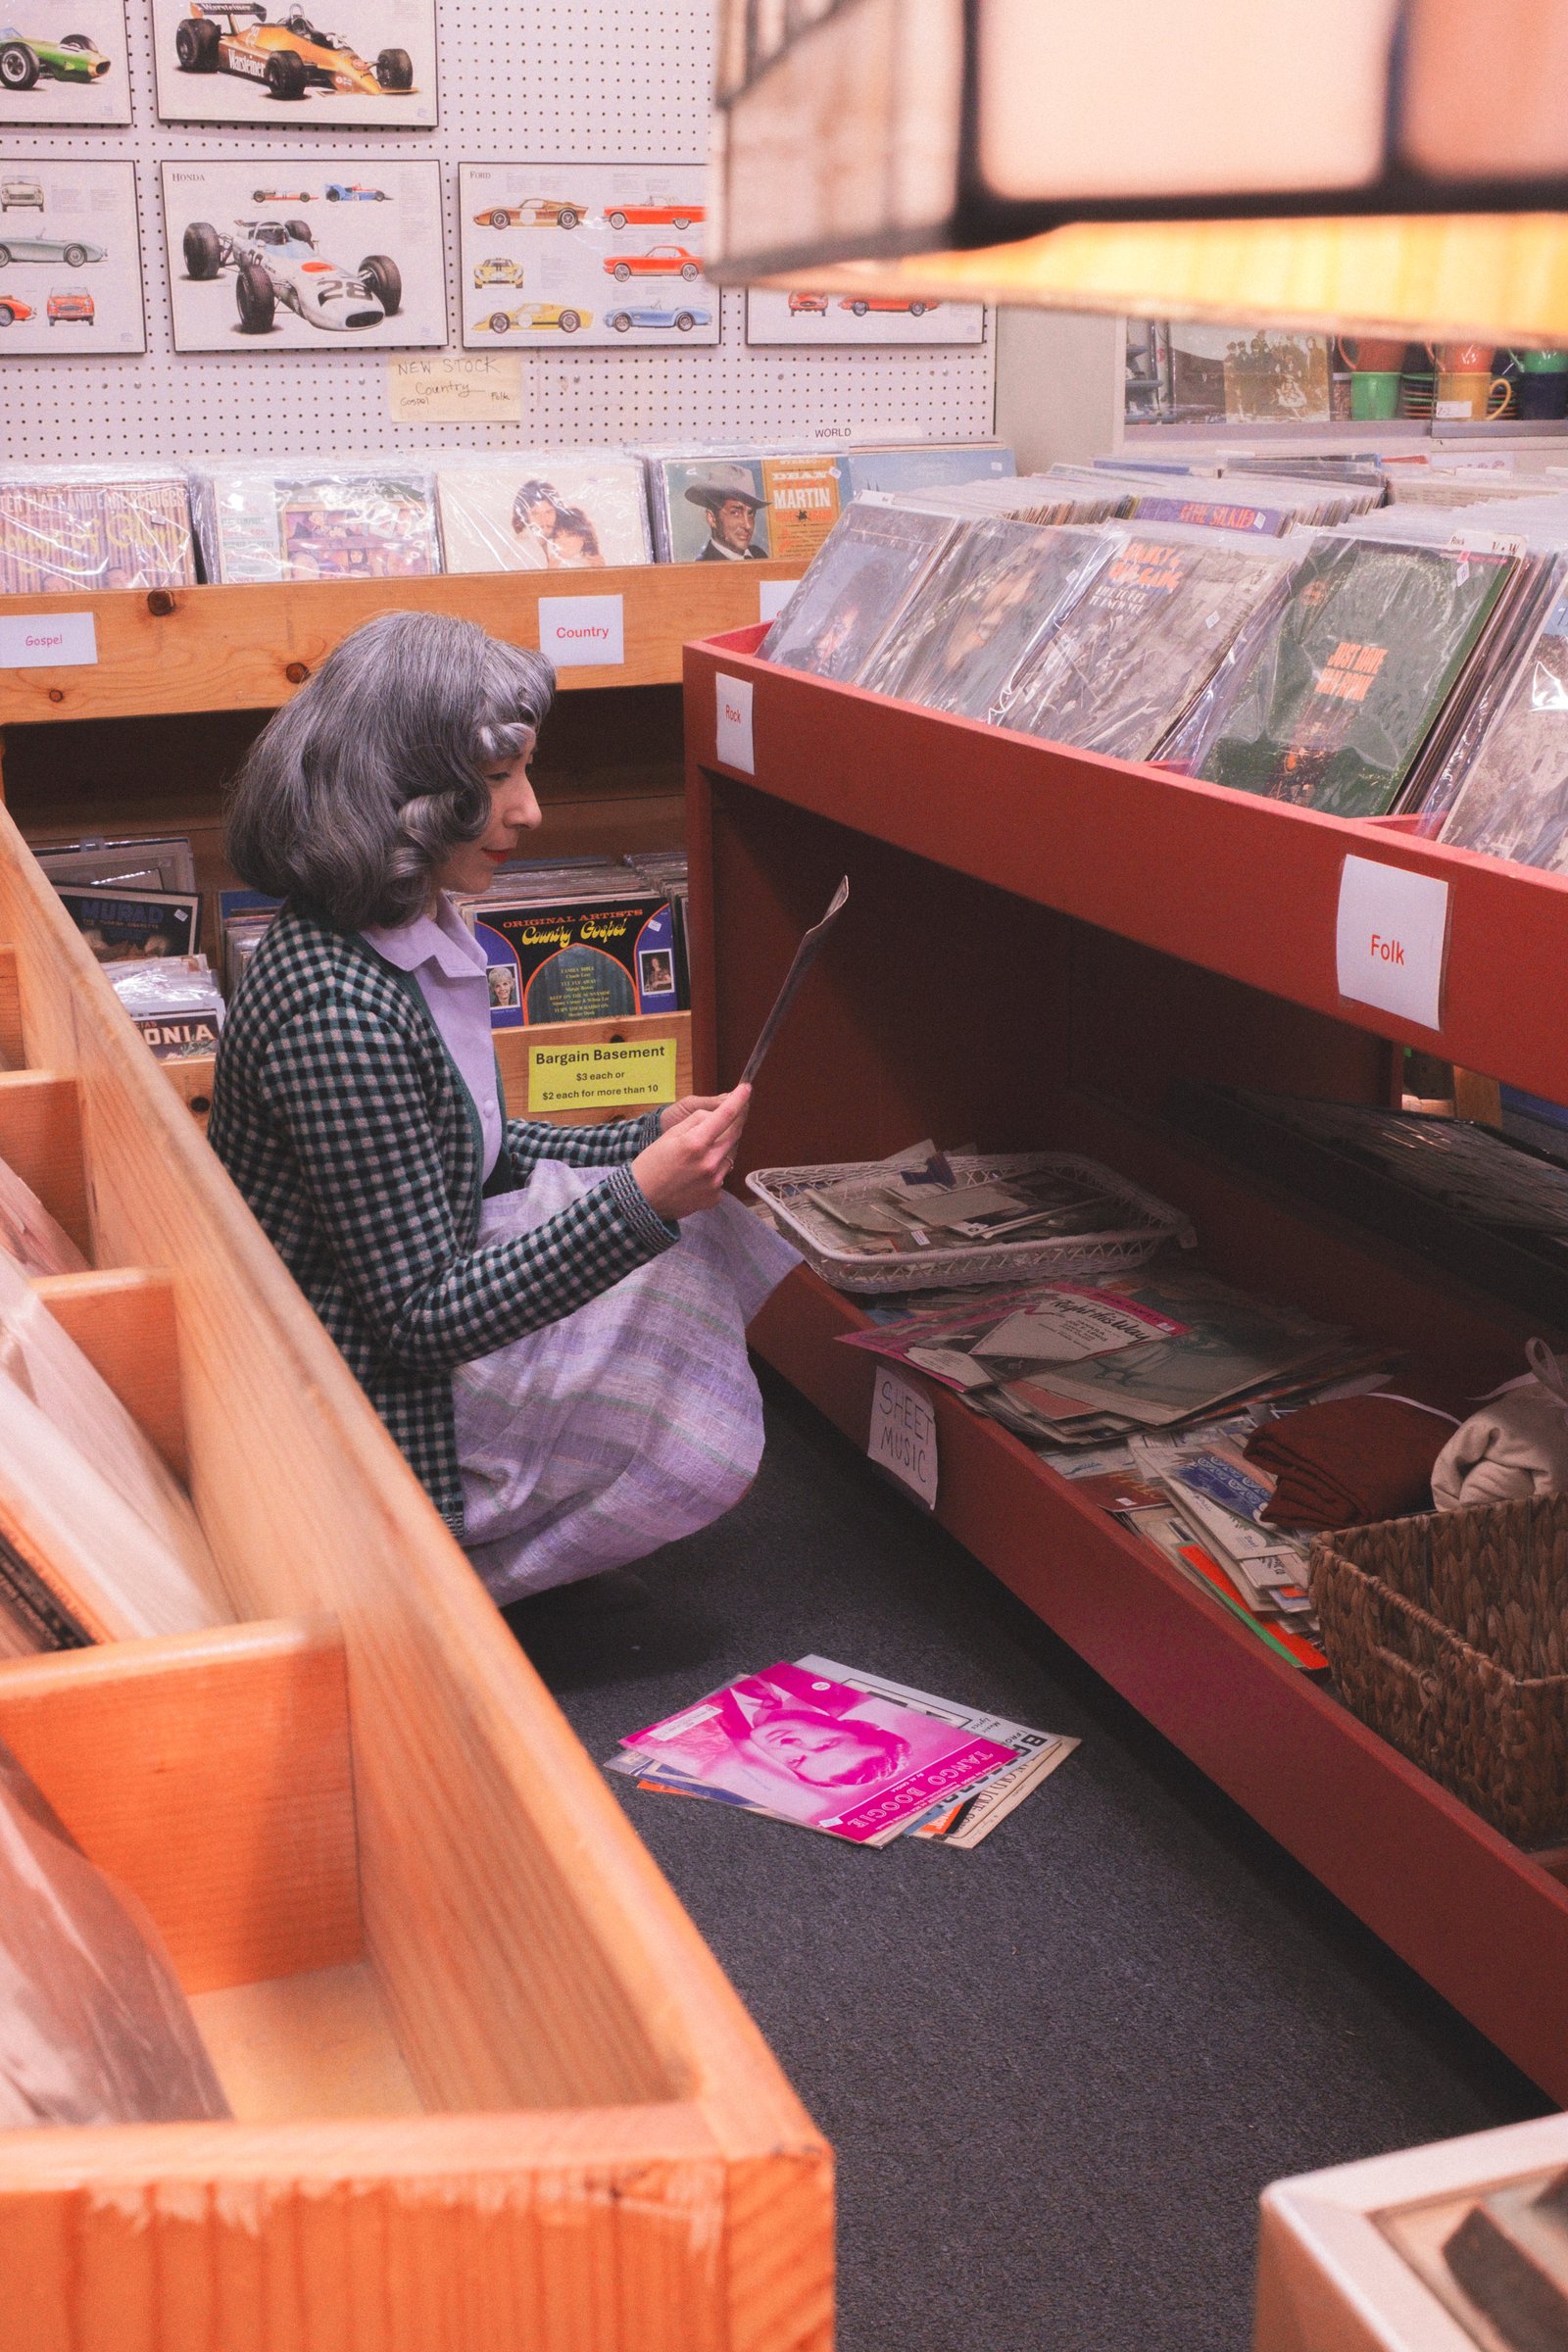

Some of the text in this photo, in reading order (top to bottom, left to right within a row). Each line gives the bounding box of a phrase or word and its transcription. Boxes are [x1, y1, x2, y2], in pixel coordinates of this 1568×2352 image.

[202, 3, 252, 12] Warsteiner
[227, 48, 266, 78] Warsteiner
[172, 173, 205, 182] HONDA
[468, 170, 491, 180] FORD
[317, 279, 373, 308] 28
[398, 356, 501, 375] NEW STOCK
[415, 381, 485, 398] Country
[400, 396, 429, 407] Gospel
[814, 427, 852, 439] WORLD
[772, 470, 828, 481] DEAN
[67, 492, 93, 511] AND
[128, 489, 184, 509] SCRUGGS
[772, 487, 832, 510] MARTIN
[25, 634, 64, 648] Gospel
[556, 625, 610, 641] Country
[725, 705, 742, 725] Rock
[81, 900, 165, 924] MURAD
[503, 908, 643, 929] ORIGINAL ARTISTS
[521, 917, 628, 949] Country Gospel
[1370, 934, 1405, 966] Folk
[536, 1046, 665, 1068] Bargain Basement
[576, 1072, 588, 1082] $3
[590, 1070, 613, 1080] each
[542, 1084, 659, 1102] $2 each for more than 10
[1050, 1298, 1093, 1320] Right
[1090, 1309, 1117, 1326] this
[1111, 1317, 1151, 1346] Way
[879, 1380, 935, 1442] SHEET
[881, 1425, 928, 1483] MUSIC
[971, 1716, 992, 1731] Lyrics
[982, 1720, 1001, 1734] Music
[927, 1749, 994, 1787] TANGO
[846, 1787, 925, 1829] BOOGIE
